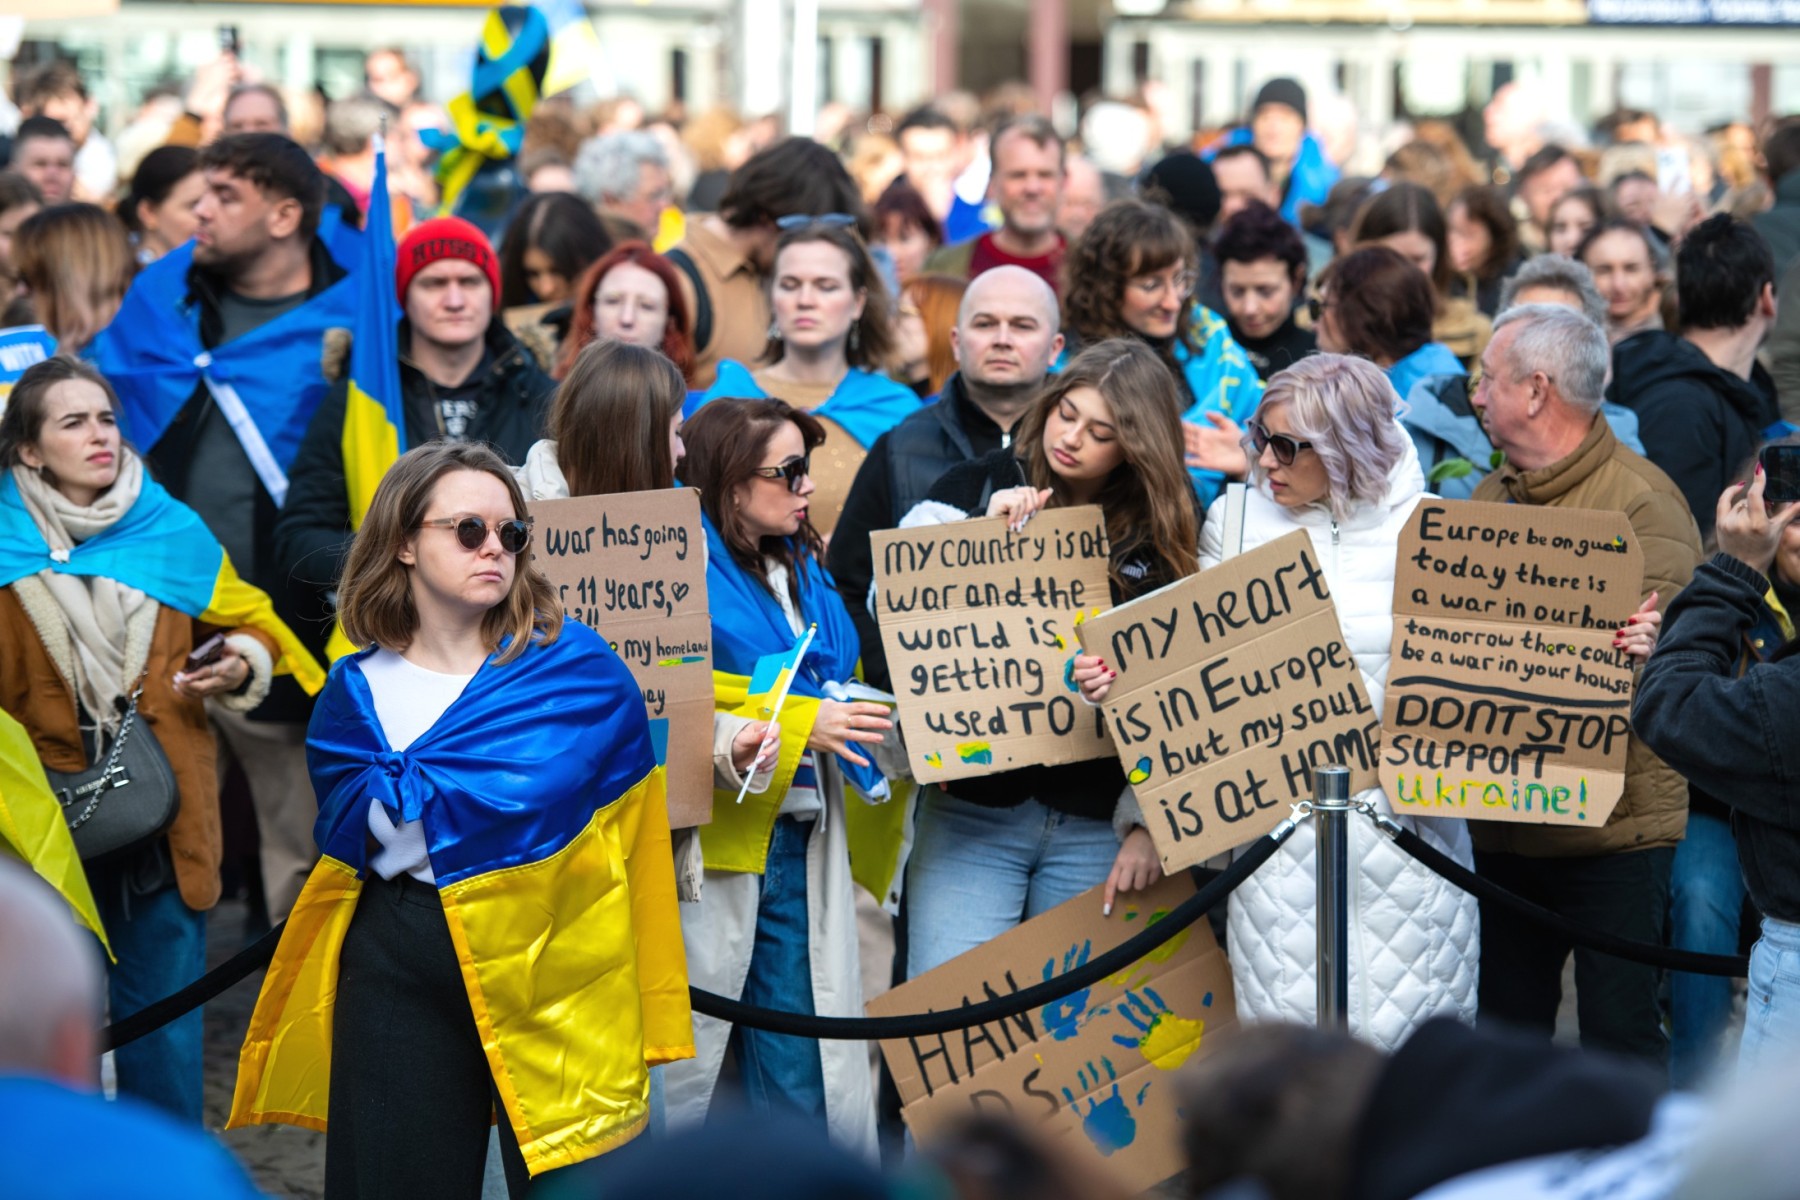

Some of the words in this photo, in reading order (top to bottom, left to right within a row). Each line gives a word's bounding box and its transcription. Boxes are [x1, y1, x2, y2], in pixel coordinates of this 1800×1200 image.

[546, 526, 596, 557] war
[602, 512, 641, 548] has
[640, 525, 688, 560] going
[940, 531, 1046, 568] country
[1055, 529, 1075, 560] is
[1080, 525, 1110, 559] at
[1419, 507, 1520, 545] Europe
[1527, 528, 1547, 546] be
[1552, 536, 1573, 550] on
[1411, 547, 1507, 590] today
[1515, 562, 1580, 590] there
[1588, 575, 1606, 593] is
[886, 583, 957, 613] war
[965, 577, 1028, 608] and
[1031, 577, 1086, 610] the
[1111, 608, 1178, 673] my
[1193, 550, 1331, 643] heart
[1411, 588, 1430, 606] a
[1440, 591, 1497, 614] war
[1506, 597, 1526, 618] in
[1534, 605, 1579, 625] our
[1581, 605, 1630, 630] hous
[625, 639, 651, 666] my
[1404, 618, 1514, 650] tomorrow
[1520, 631, 1576, 656] there
[1400, 640, 1425, 664] be
[1430, 649, 1444, 664] a
[1449, 651, 1495, 672] war
[1498, 656, 1518, 673] in
[1519, 662, 1571, 682] your
[1575, 664, 1631, 695] house
[1111, 702, 1151, 745] is
[1154, 687, 1200, 732] in
[1200, 641, 1356, 714] Europe,
[924, 702, 1010, 737] used
[1526, 708, 1630, 756] STOP
[1160, 729, 1230, 778] but
[1241, 713, 1284, 748] my
[1159, 791, 1203, 842] is
[1214, 769, 1279, 824] at
